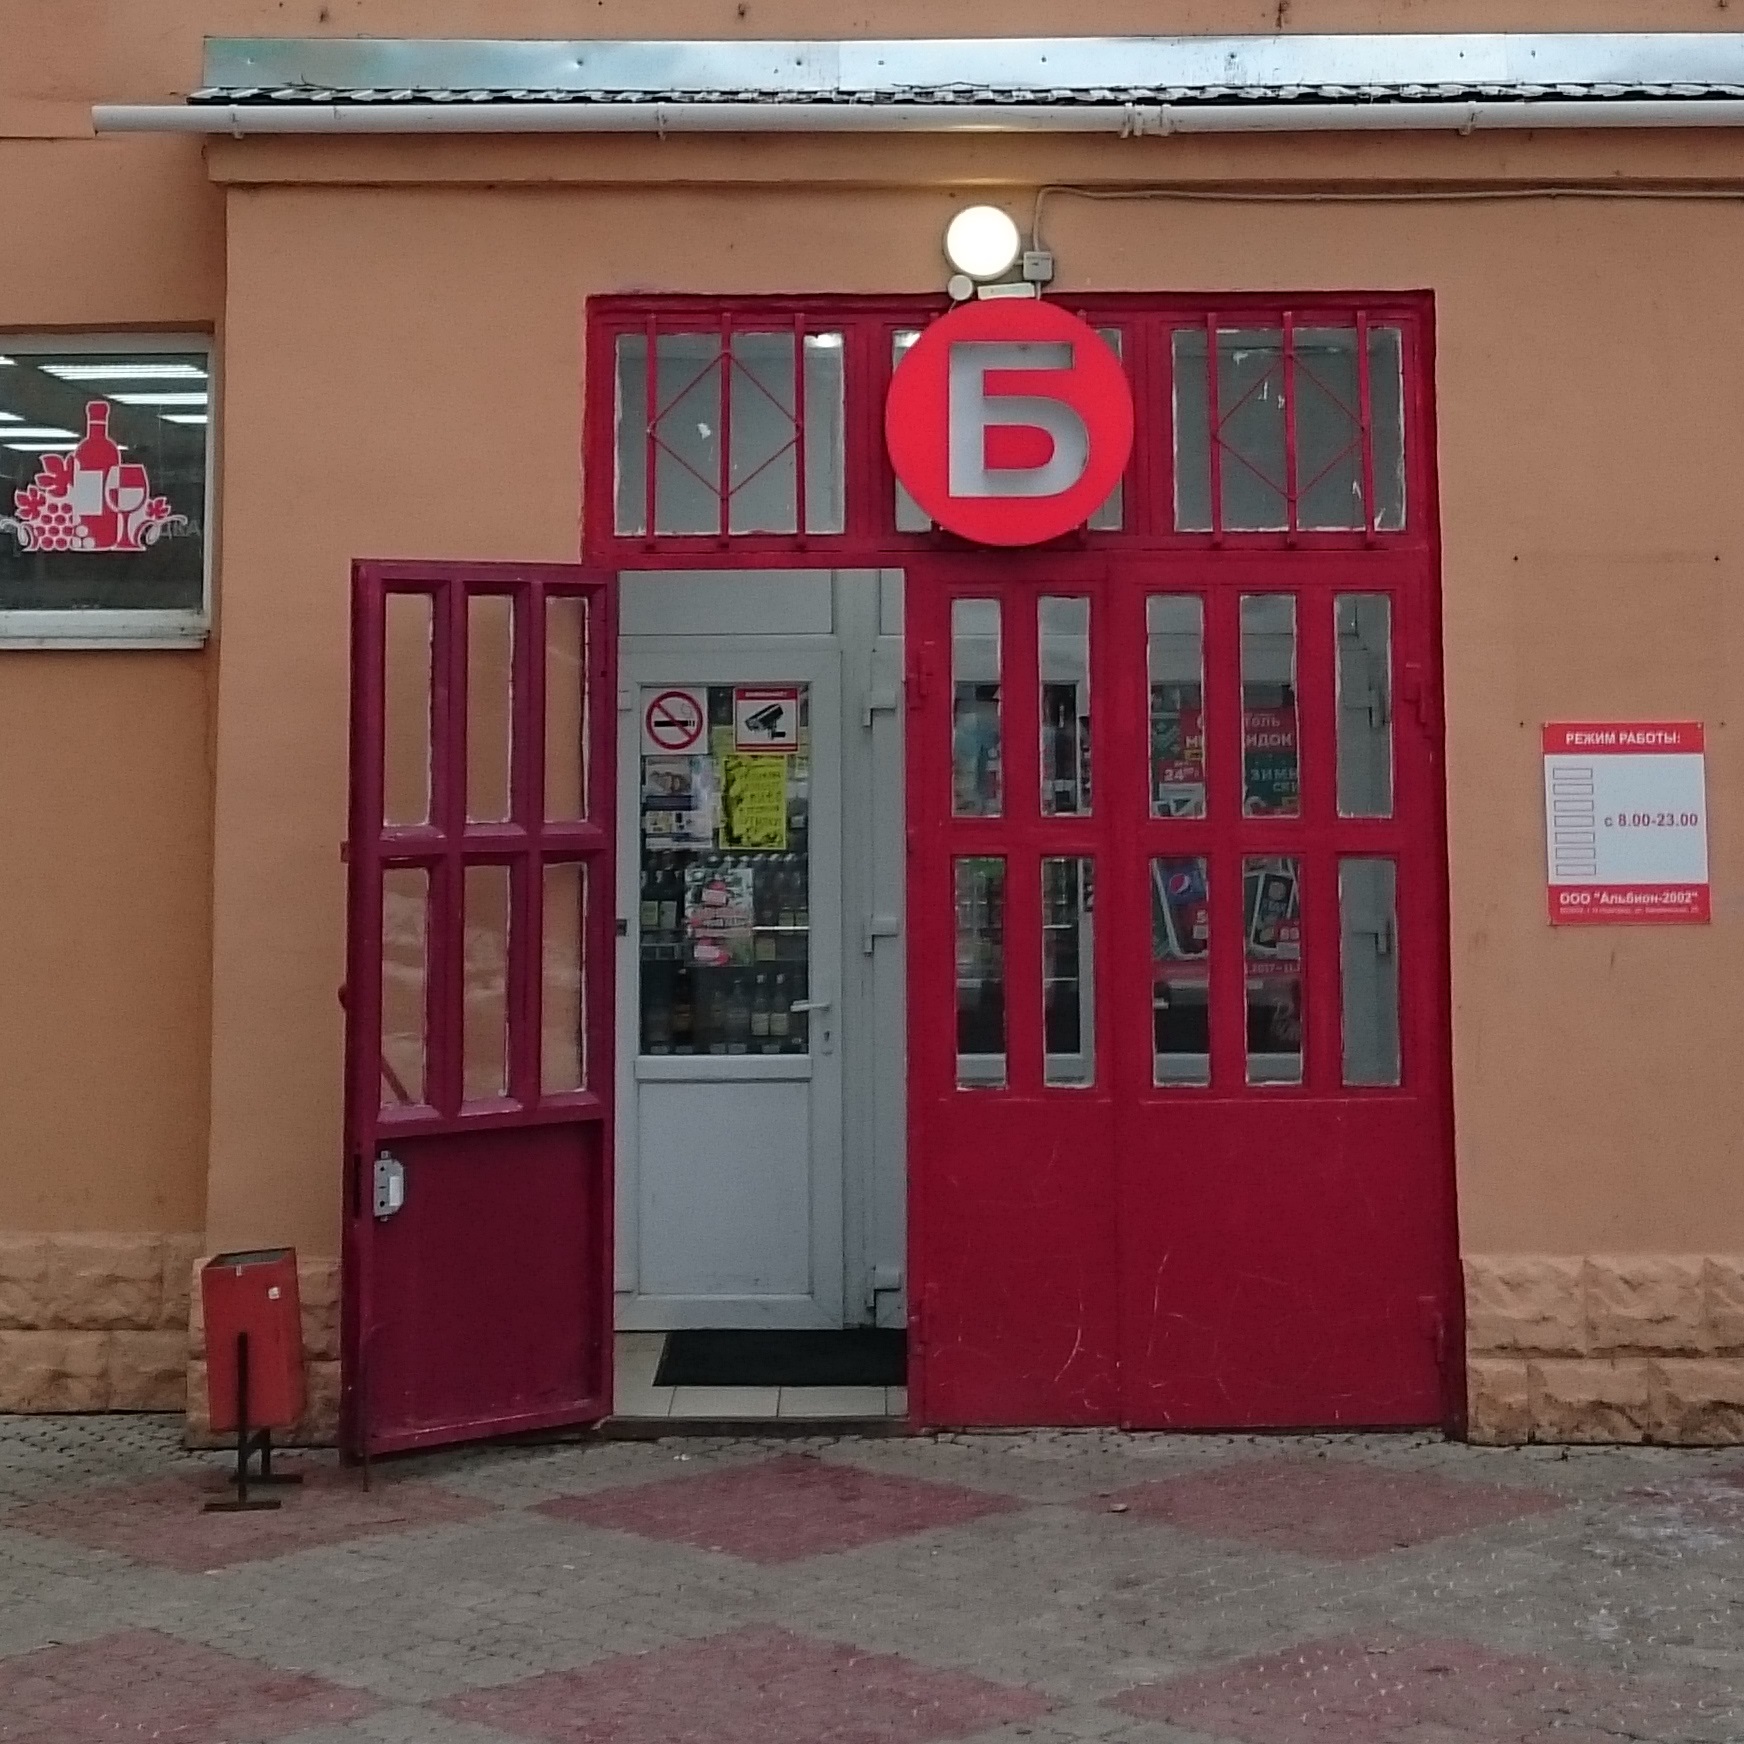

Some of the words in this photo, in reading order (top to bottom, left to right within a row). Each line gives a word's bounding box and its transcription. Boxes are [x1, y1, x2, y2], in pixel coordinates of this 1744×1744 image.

[949, 341, 1090, 498] Б
[1565, 732, 1616, 745] РЕЖИМ
[1619, 731, 1681, 744] РАБОТЫ:
[1618, 813, 1699, 827] 8.00-23.00
[1560, 893, 1591, 905] ООО
